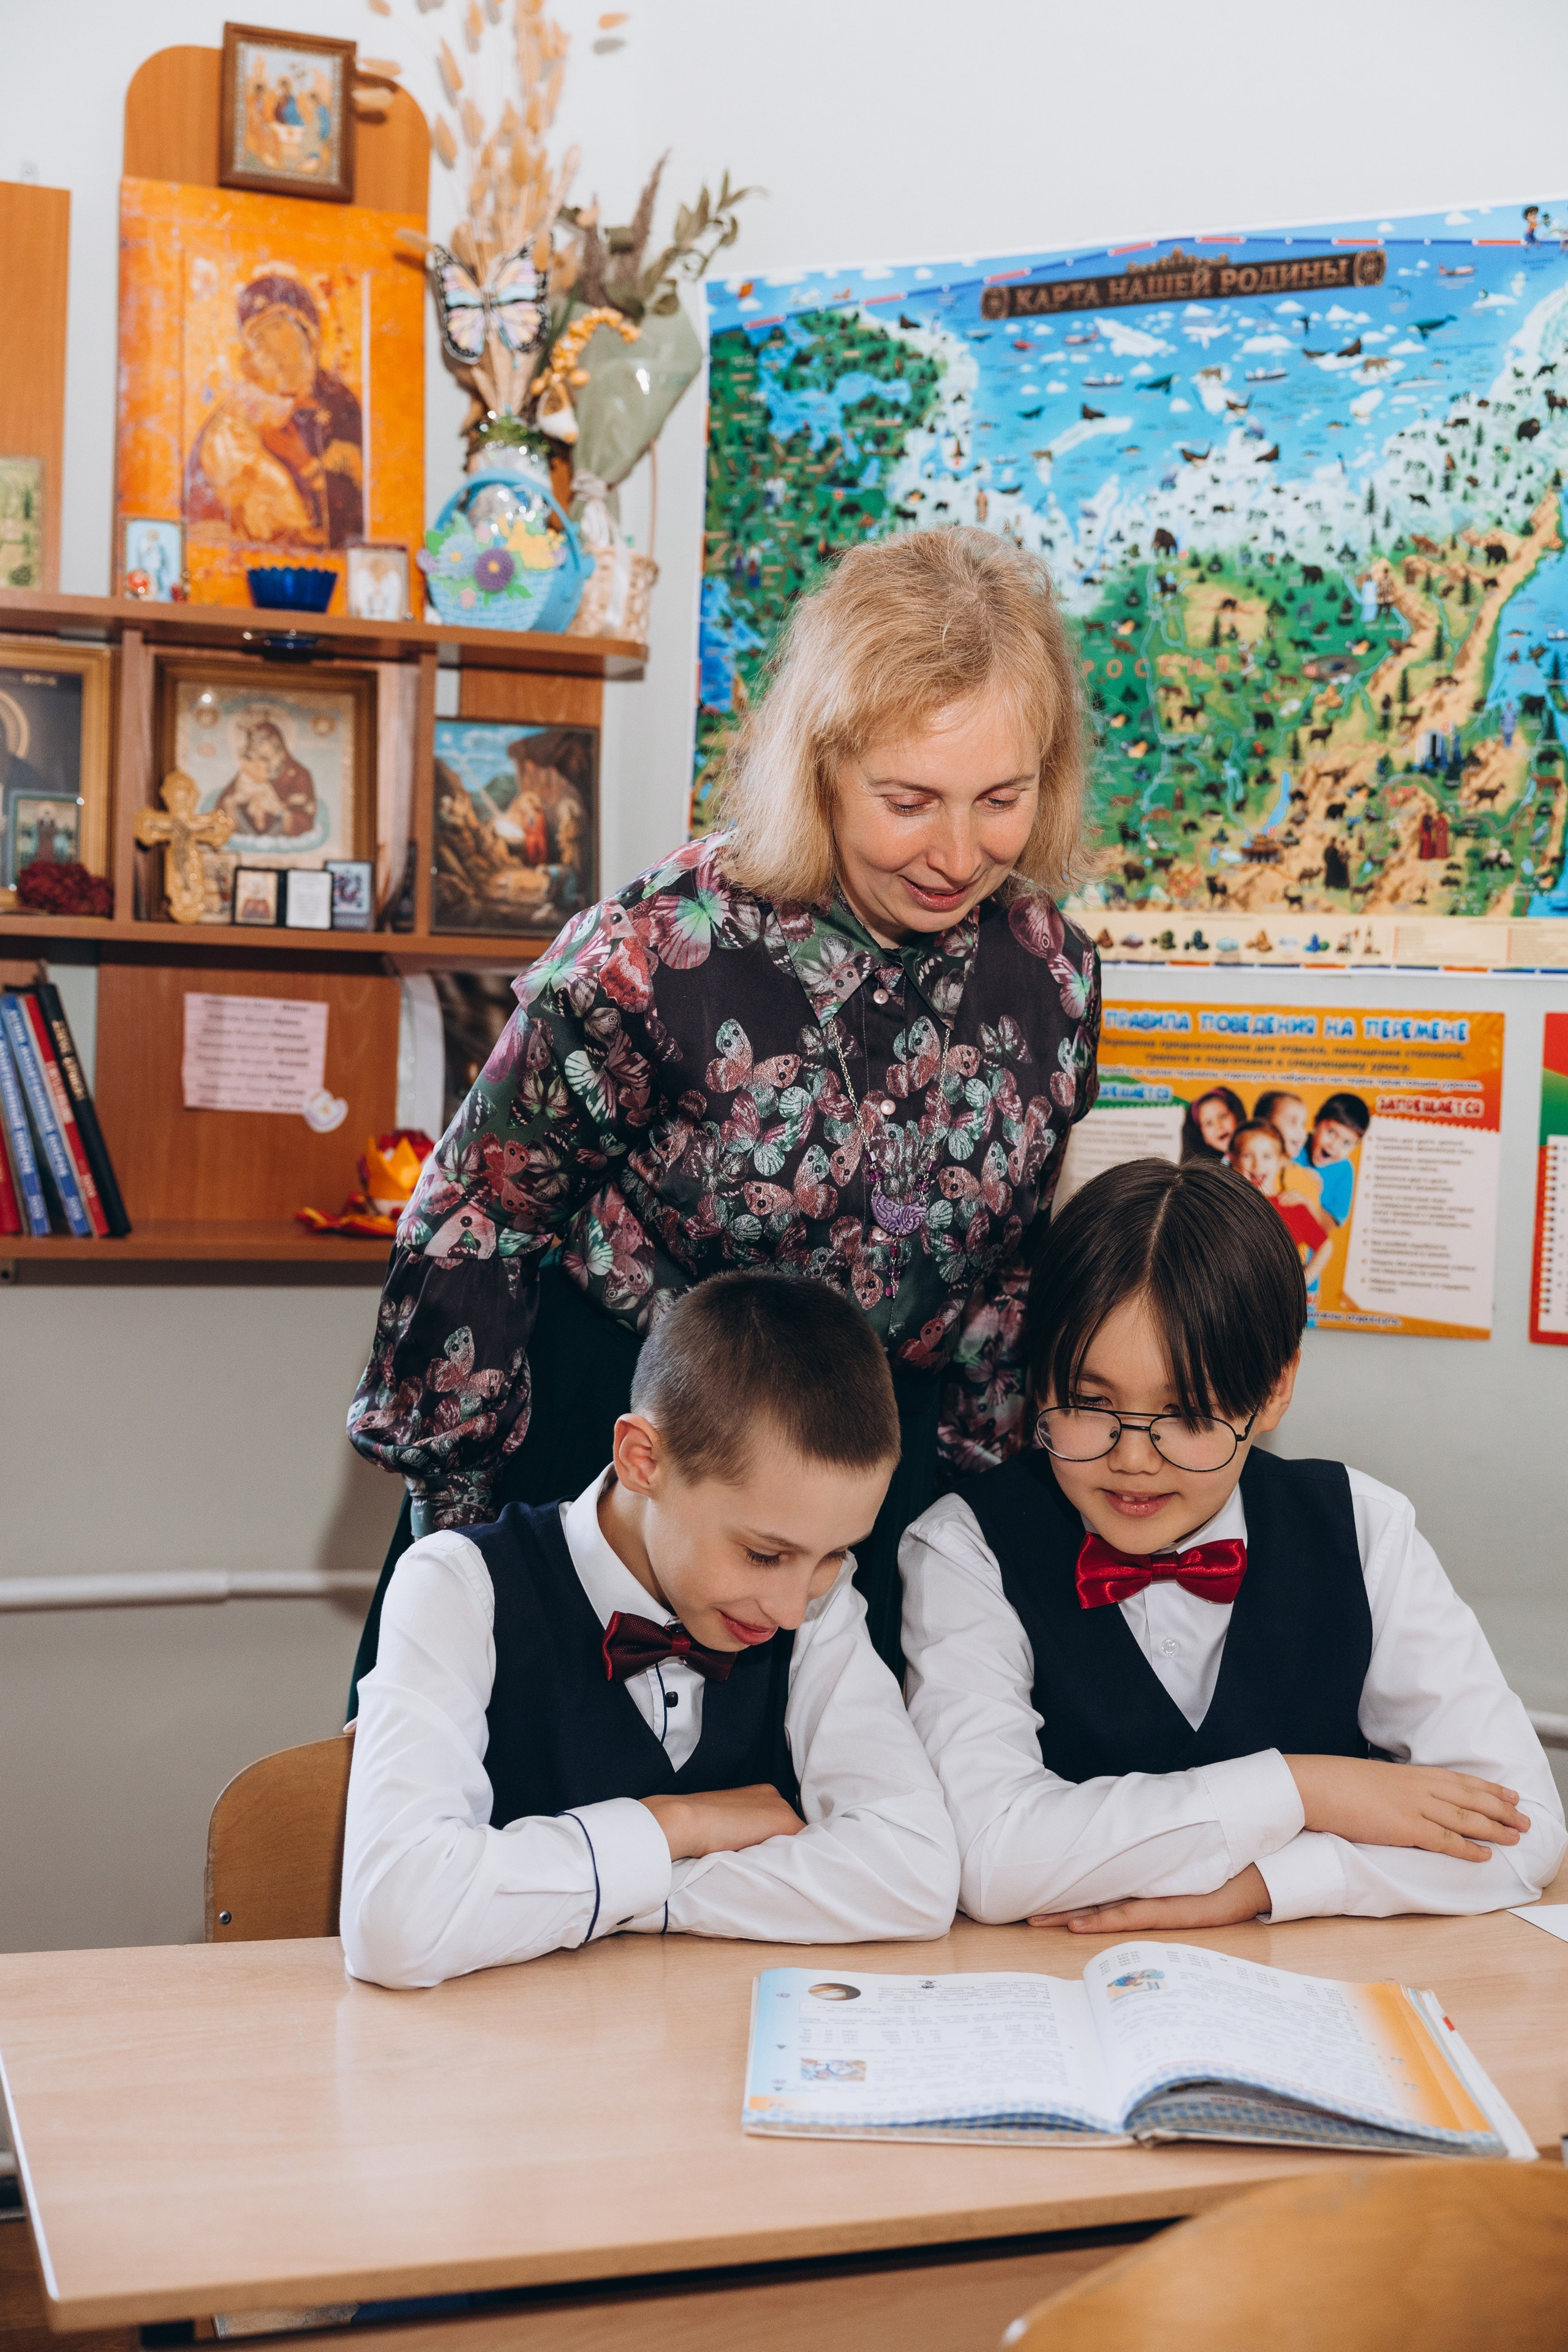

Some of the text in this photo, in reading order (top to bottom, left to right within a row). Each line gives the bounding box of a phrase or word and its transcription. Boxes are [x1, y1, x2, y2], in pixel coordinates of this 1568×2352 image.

[1015, 257, 1348, 307] КАРТА НАШЕЙ РОДИНЫ
[1104, 1010, 1469, 1041] ПРАВИЛА ПОВЕДЕНИЯ НА ПЕРЕМЕНЕ
[1379, 1098, 1480, 1115] ЗАПРЕЩАЕТСЯ
